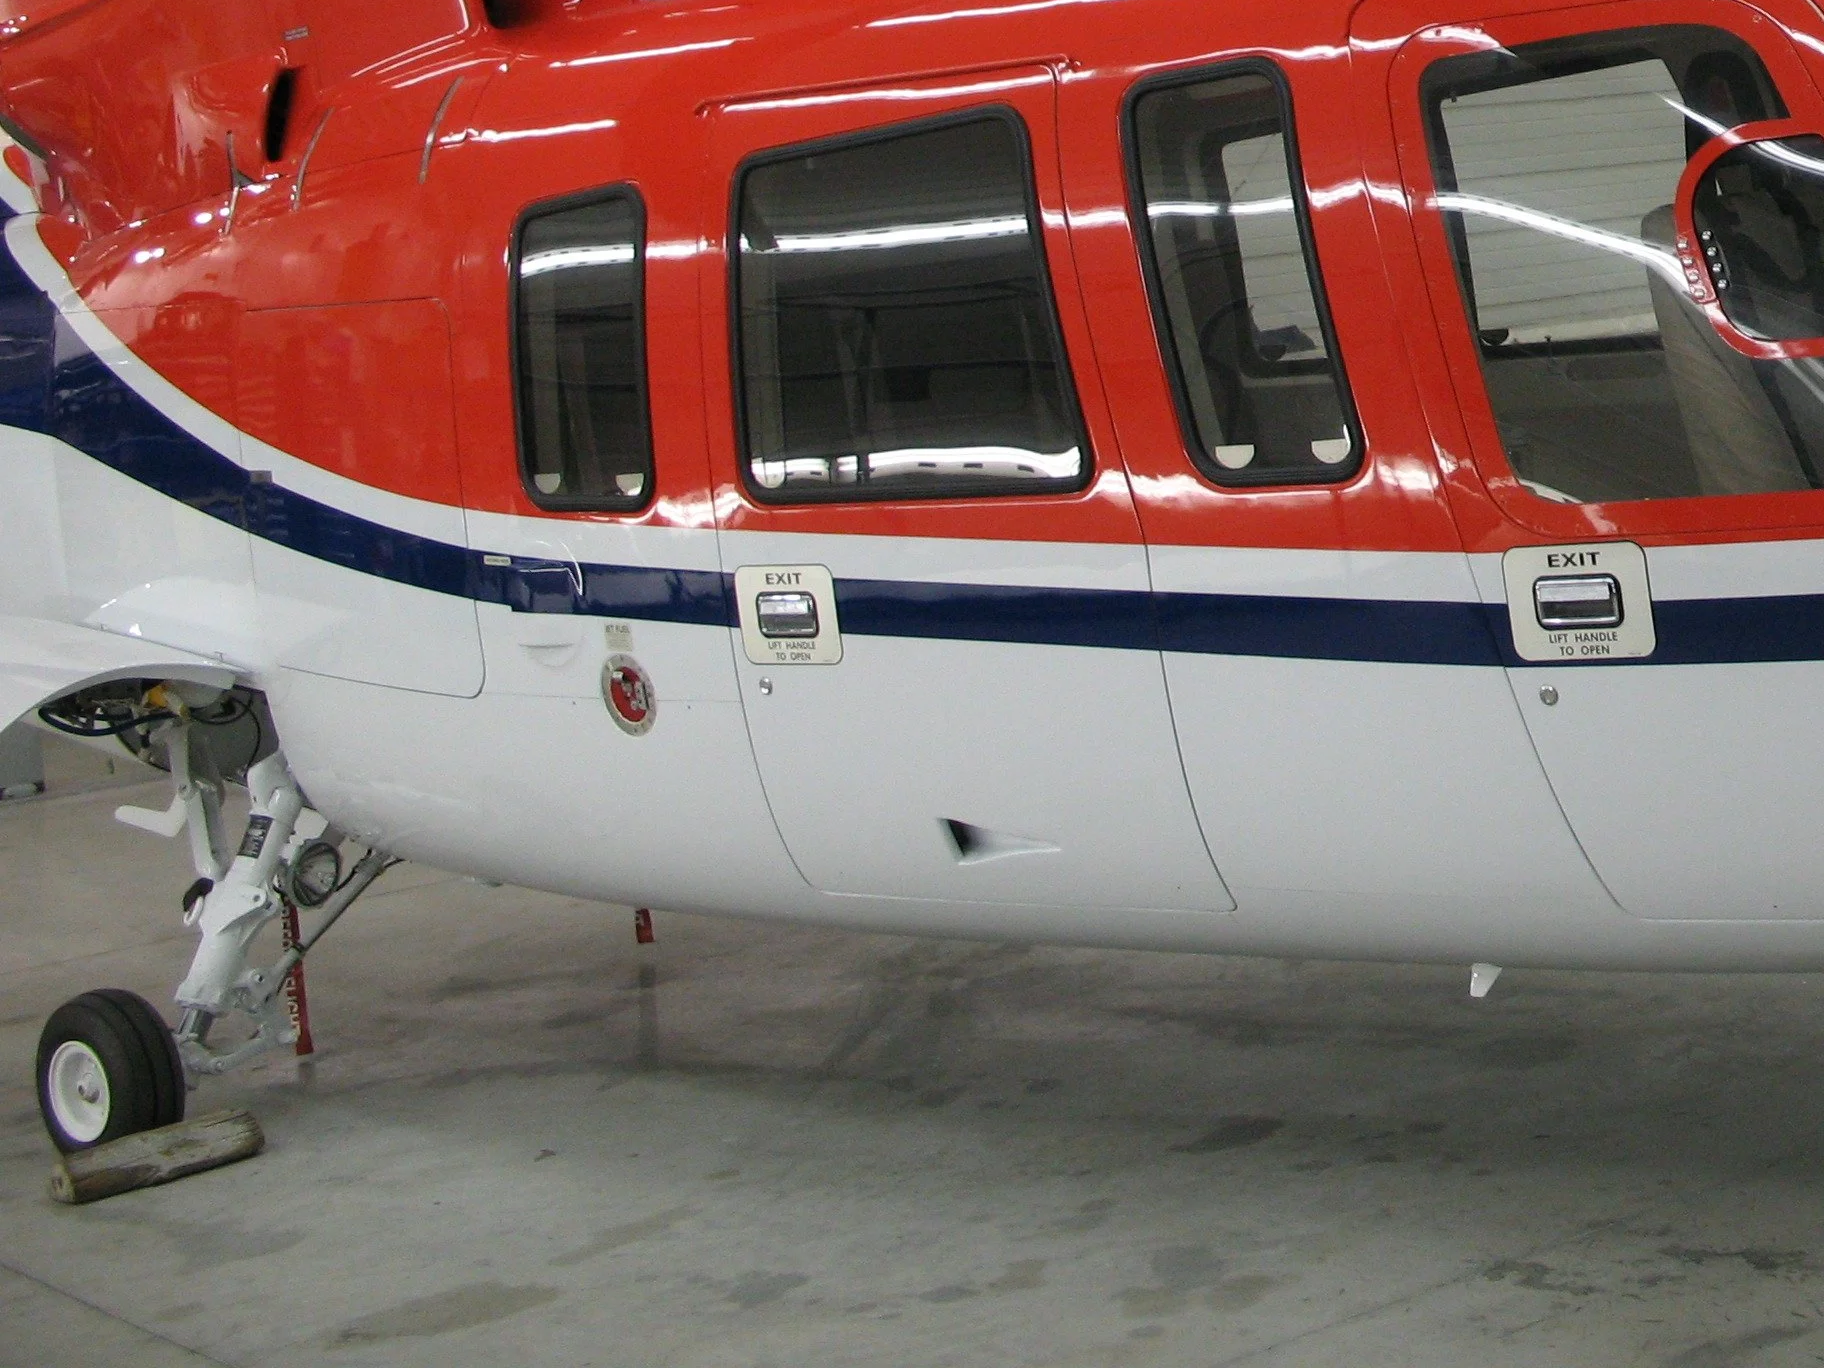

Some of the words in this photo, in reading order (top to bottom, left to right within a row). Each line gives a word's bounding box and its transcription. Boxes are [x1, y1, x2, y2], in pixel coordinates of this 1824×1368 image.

[1546, 551, 1601, 568] EXIT
[765, 572, 802, 585] EXIT
[1548, 632, 1568, 644] LIFT
[1574, 631, 1619, 643] HANDLE
[768, 641, 783, 651] LIFT
[785, 640, 816, 651] HANDLE
[1559, 646, 1575, 656] TO
[1580, 644, 1611, 655] OPEN
[775, 651, 787, 661] TO
[790, 651, 812, 661] OPEN
